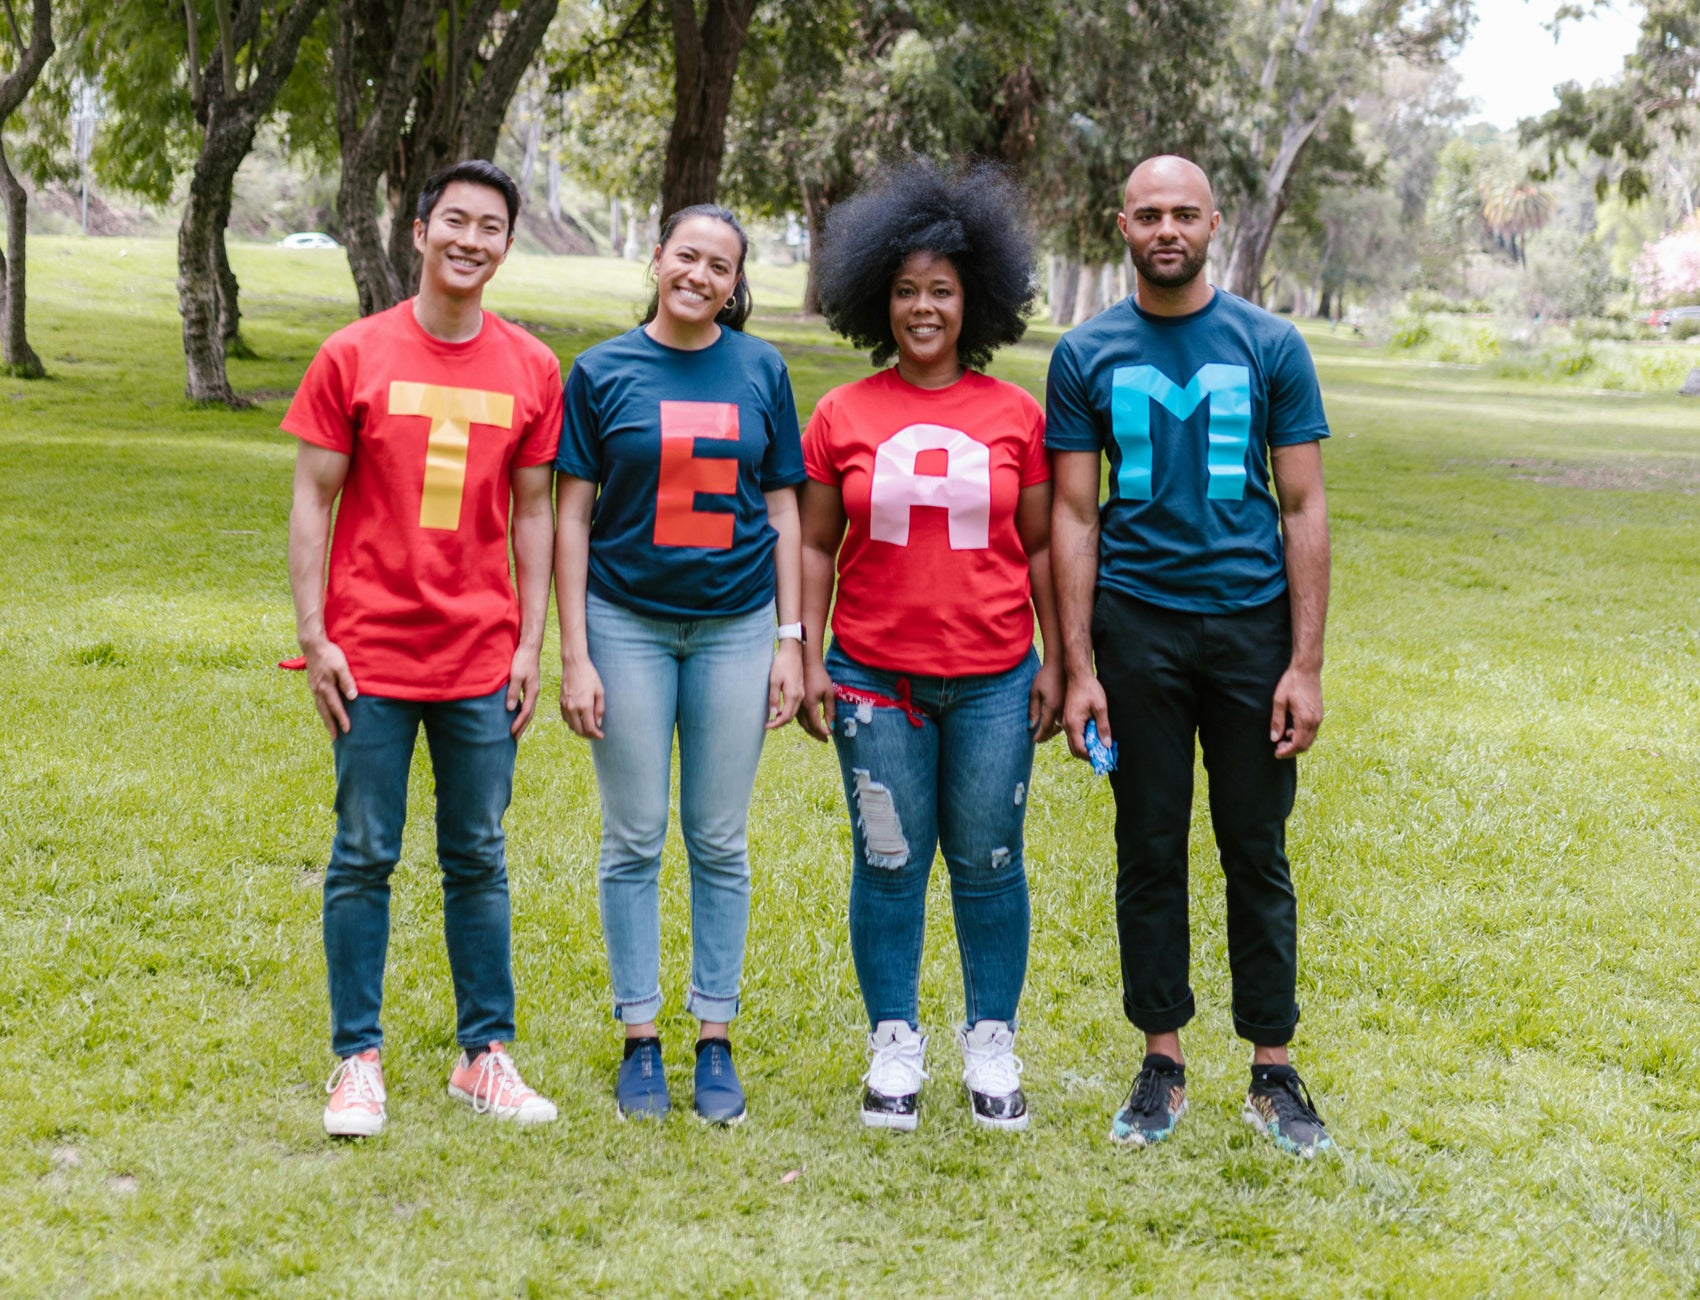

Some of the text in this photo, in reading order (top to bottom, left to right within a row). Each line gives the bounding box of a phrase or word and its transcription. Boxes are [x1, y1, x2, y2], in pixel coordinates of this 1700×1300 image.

[388, 380, 514, 530] T
[653, 400, 740, 549] E
[870, 423, 991, 550] A
[1111, 363, 1251, 500] M
